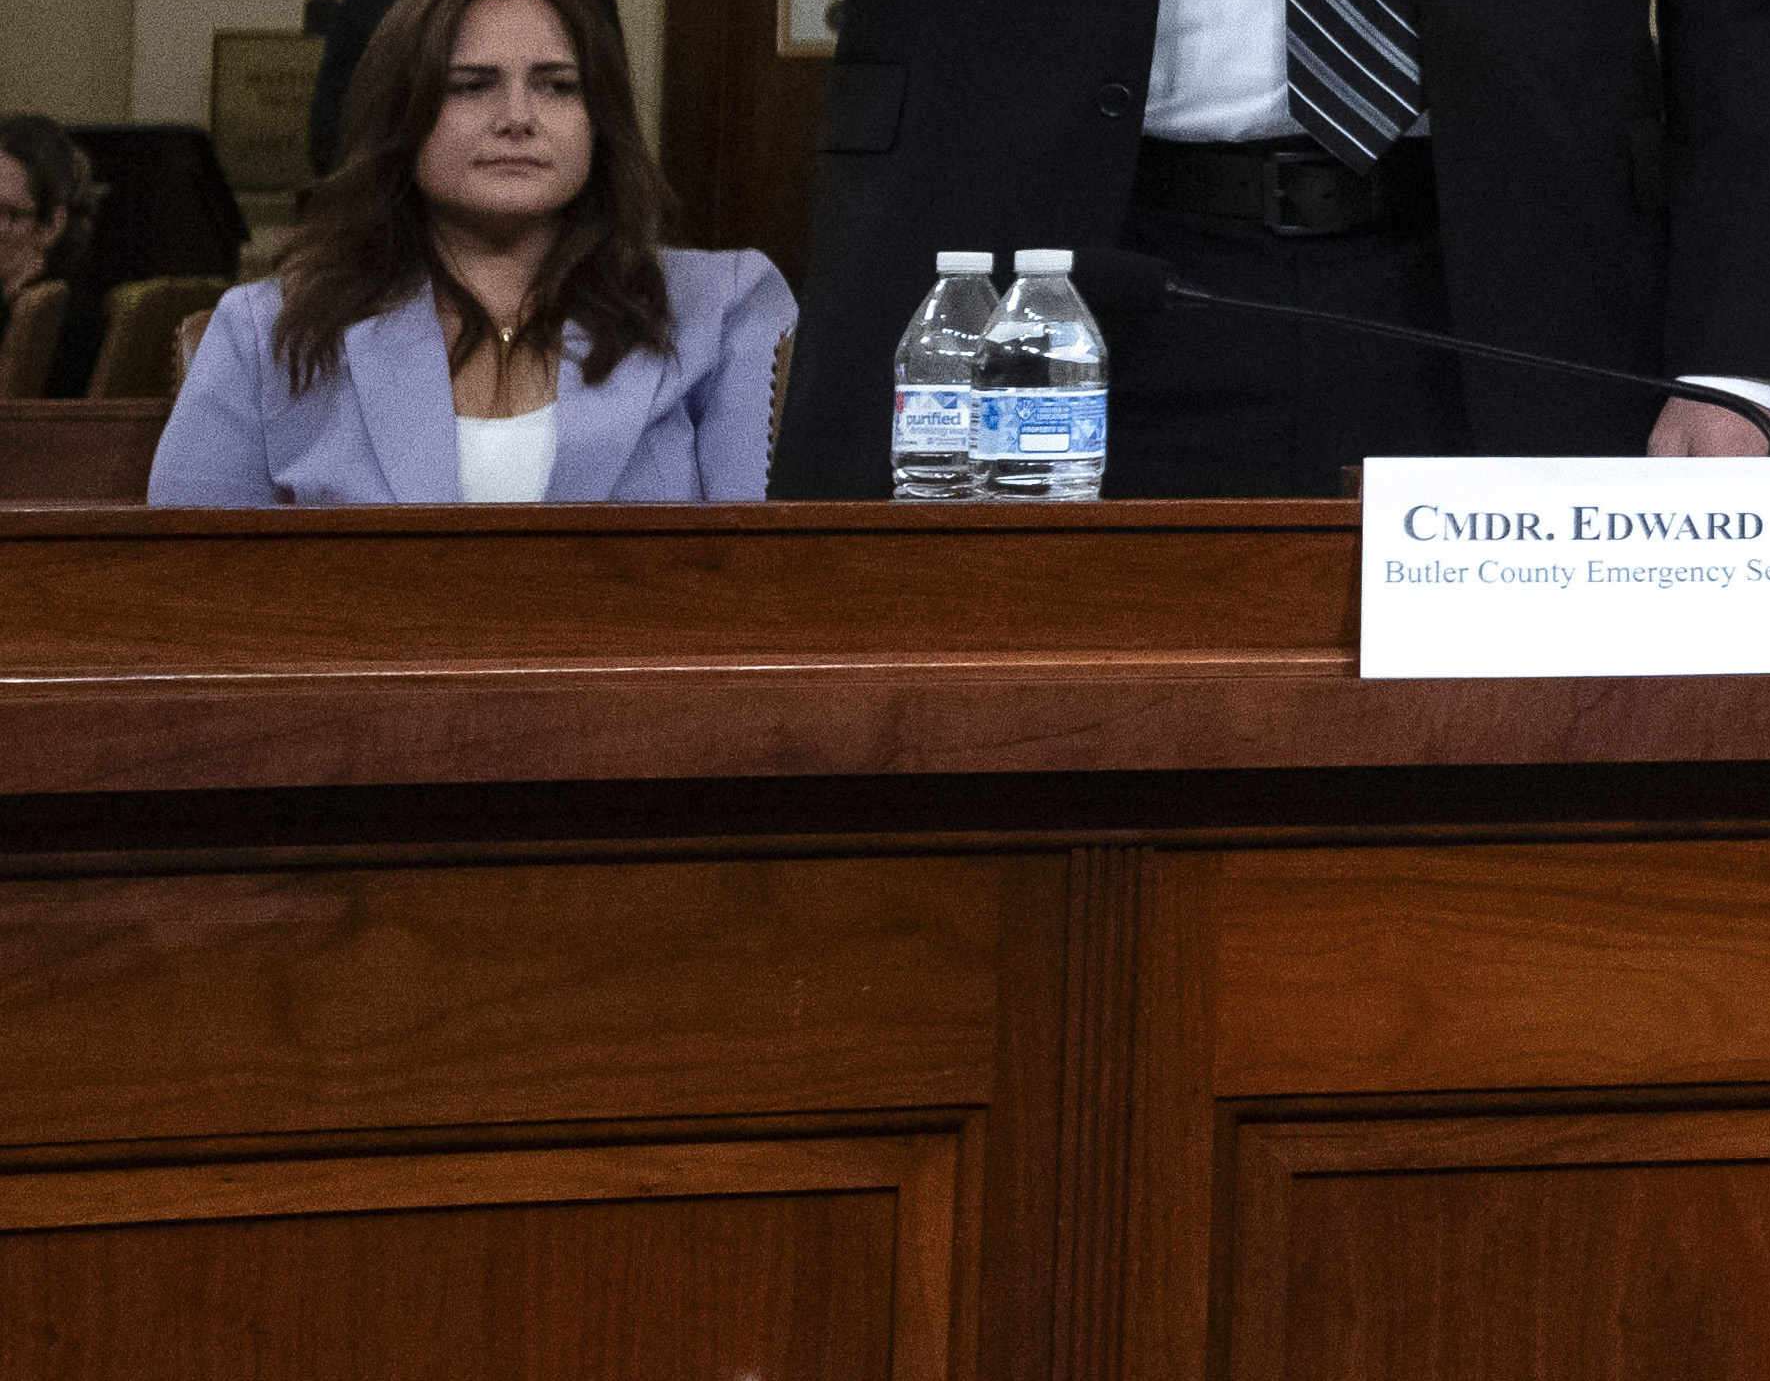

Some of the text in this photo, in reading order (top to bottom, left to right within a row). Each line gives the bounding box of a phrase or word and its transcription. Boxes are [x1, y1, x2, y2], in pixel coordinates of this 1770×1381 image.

[1402, 504, 1556, 542] CMDR.
[1571, 505, 1765, 542] EDWARD
[1384, 559, 1469, 585] Butler
[1477, 559, 1576, 590] County
[1586, 559, 1736, 590] Emergency
